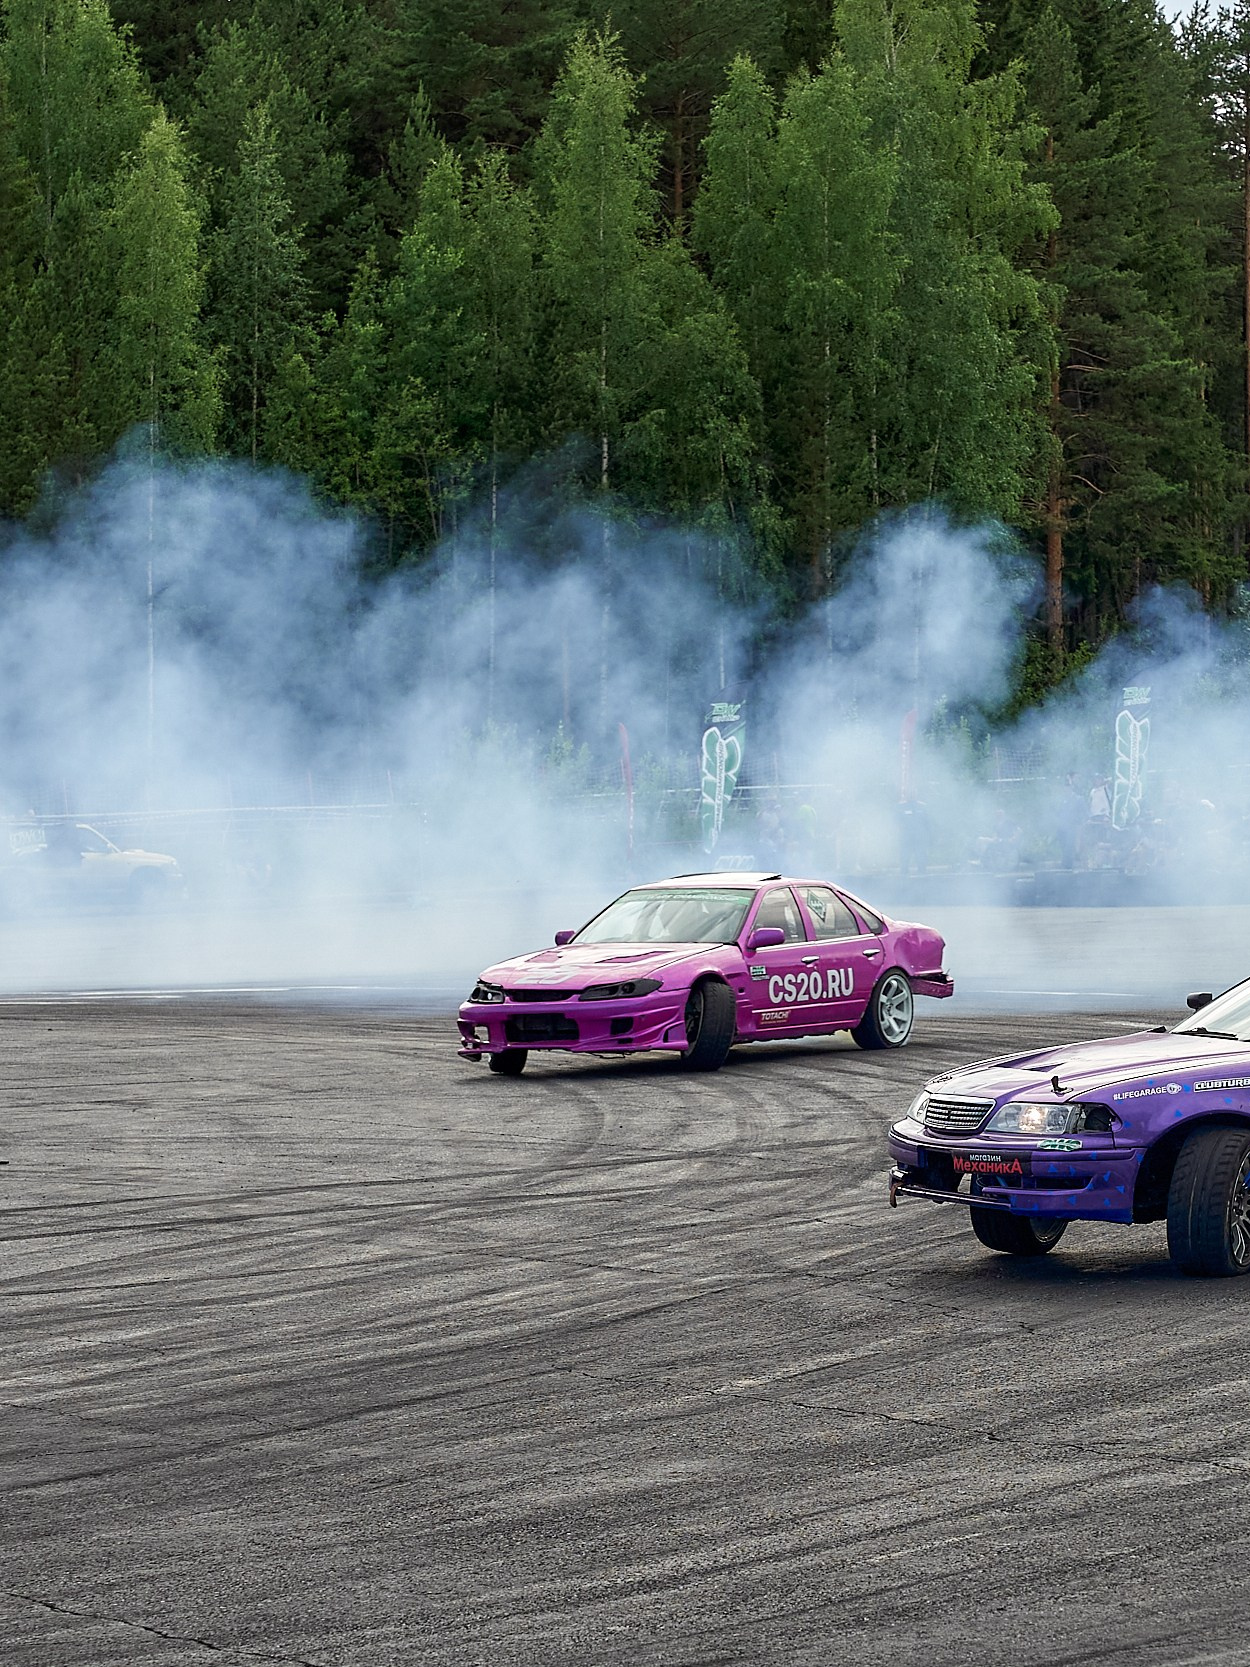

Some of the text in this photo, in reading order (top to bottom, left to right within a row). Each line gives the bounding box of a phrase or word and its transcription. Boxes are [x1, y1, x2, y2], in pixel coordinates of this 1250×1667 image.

[768, 967, 855, 1004] CS20.RU
[761, 1011, 789, 1021] TOTACHI
[969, 1154, 1002, 1162] магазин
